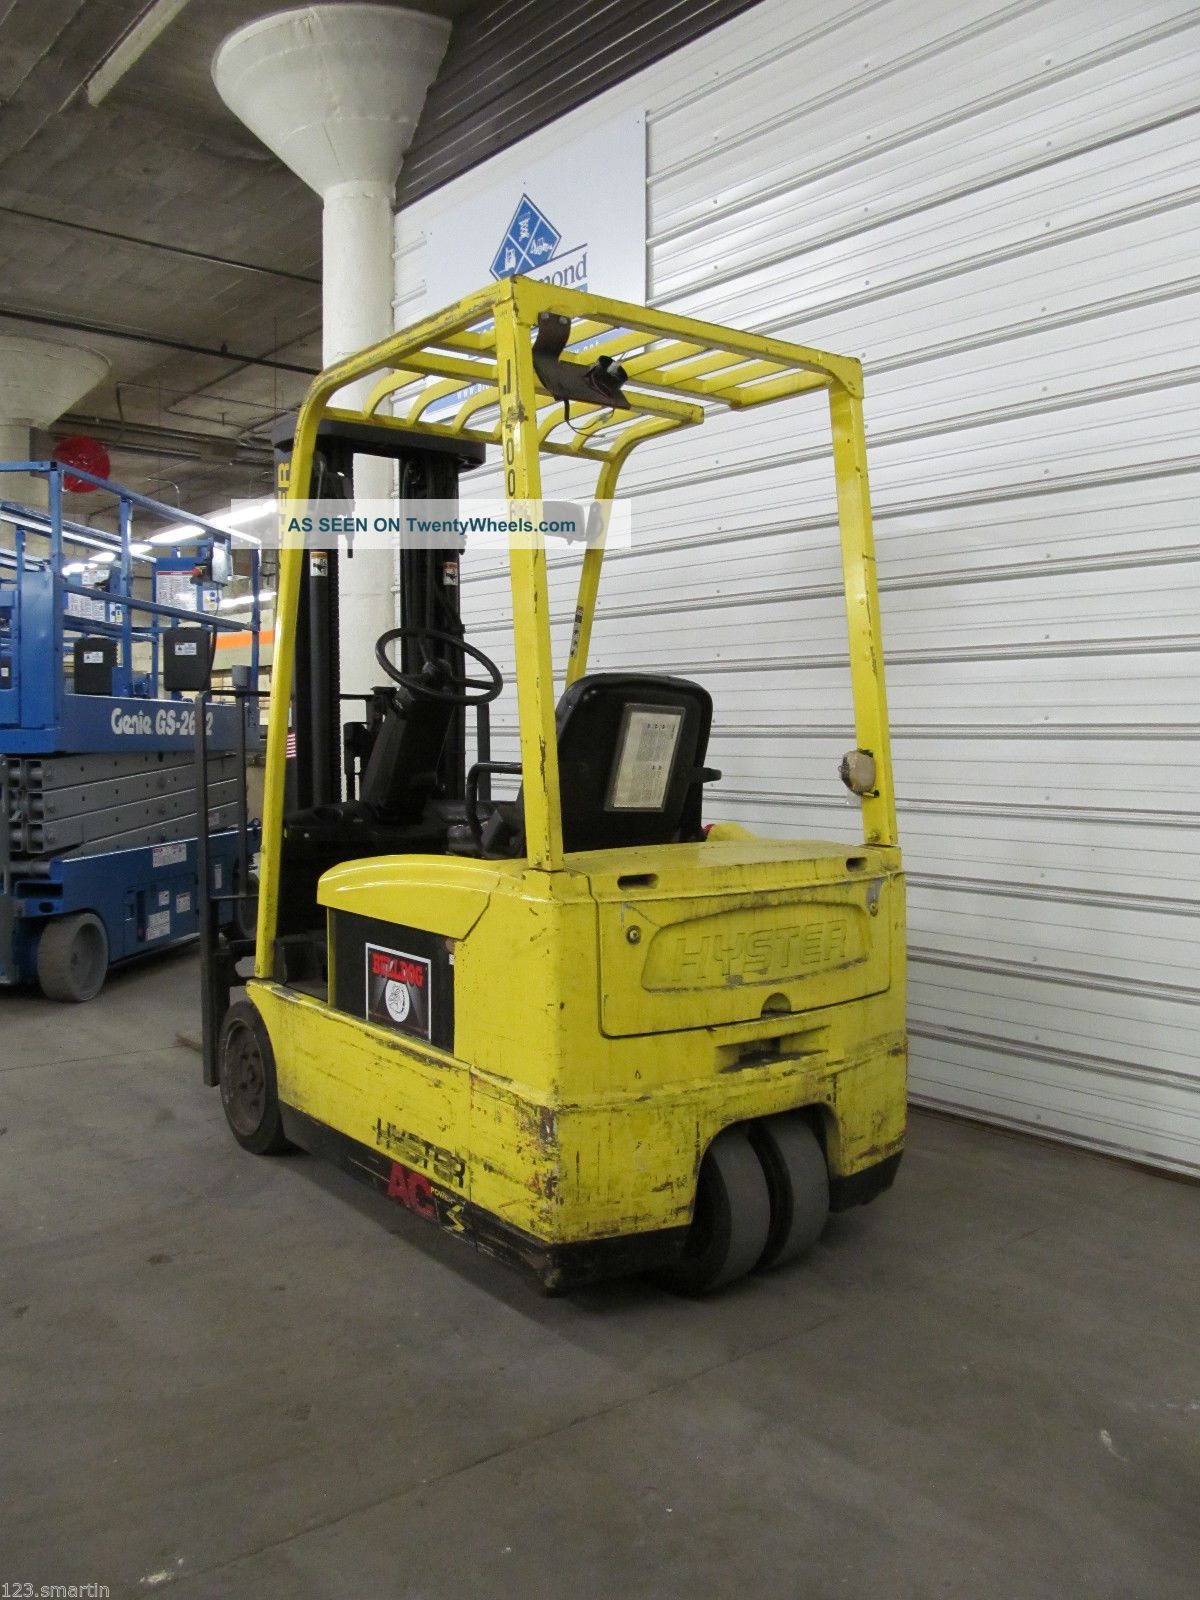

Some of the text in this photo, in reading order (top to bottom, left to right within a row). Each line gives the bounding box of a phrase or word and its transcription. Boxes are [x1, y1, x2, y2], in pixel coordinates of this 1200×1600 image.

[111, 707, 214, 736] Genie GS-262
[372, 952, 424, 991] BULLDOG
[671, 918, 847, 982] HYSTER
[387, 1159, 437, 1221] AC
